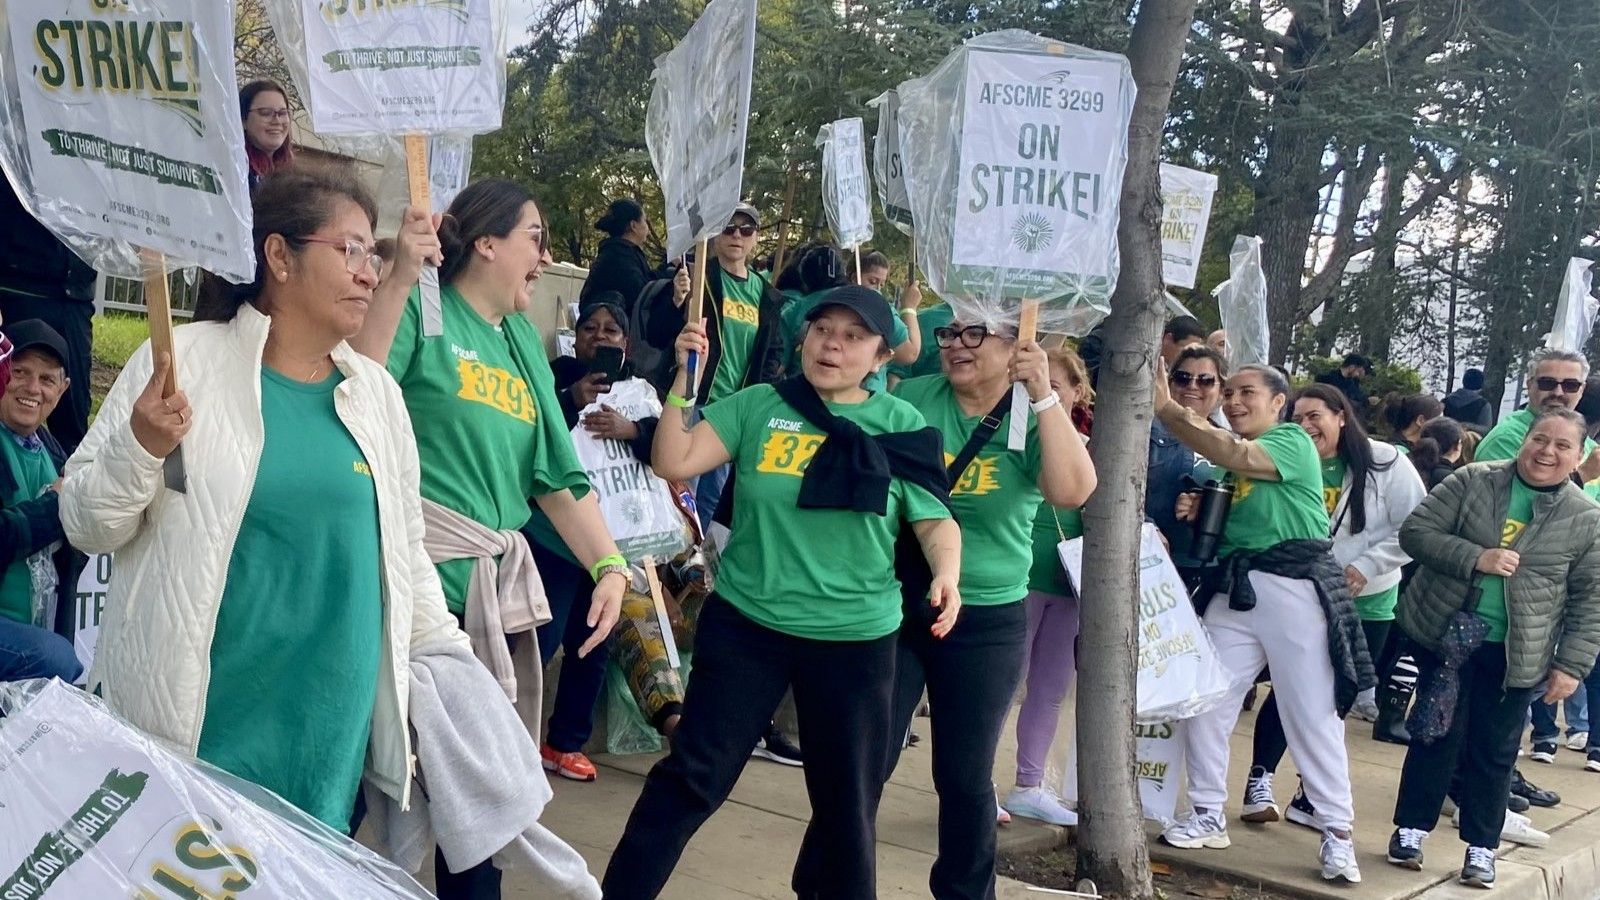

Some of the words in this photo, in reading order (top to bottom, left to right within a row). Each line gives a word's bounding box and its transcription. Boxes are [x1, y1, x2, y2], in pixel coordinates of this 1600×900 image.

[388, 52, 404, 64] NOT
[406, 51, 425, 63] JUST
[979, 82, 1052, 109] AFSCME
[1057, 88, 1104, 113] 3299
[58, 133, 72, 150] TO
[133, 152, 155, 173] JUST
[1017, 122, 1060, 162] ON
[968, 162, 1101, 222] STRIKE!
[768, 417, 804, 432] AFSCME
[774, 435, 821, 473] 32
[960, 462, 981, 492] 9
[101, 790, 131, 812] TO
[27, 852, 64, 885] NOT
